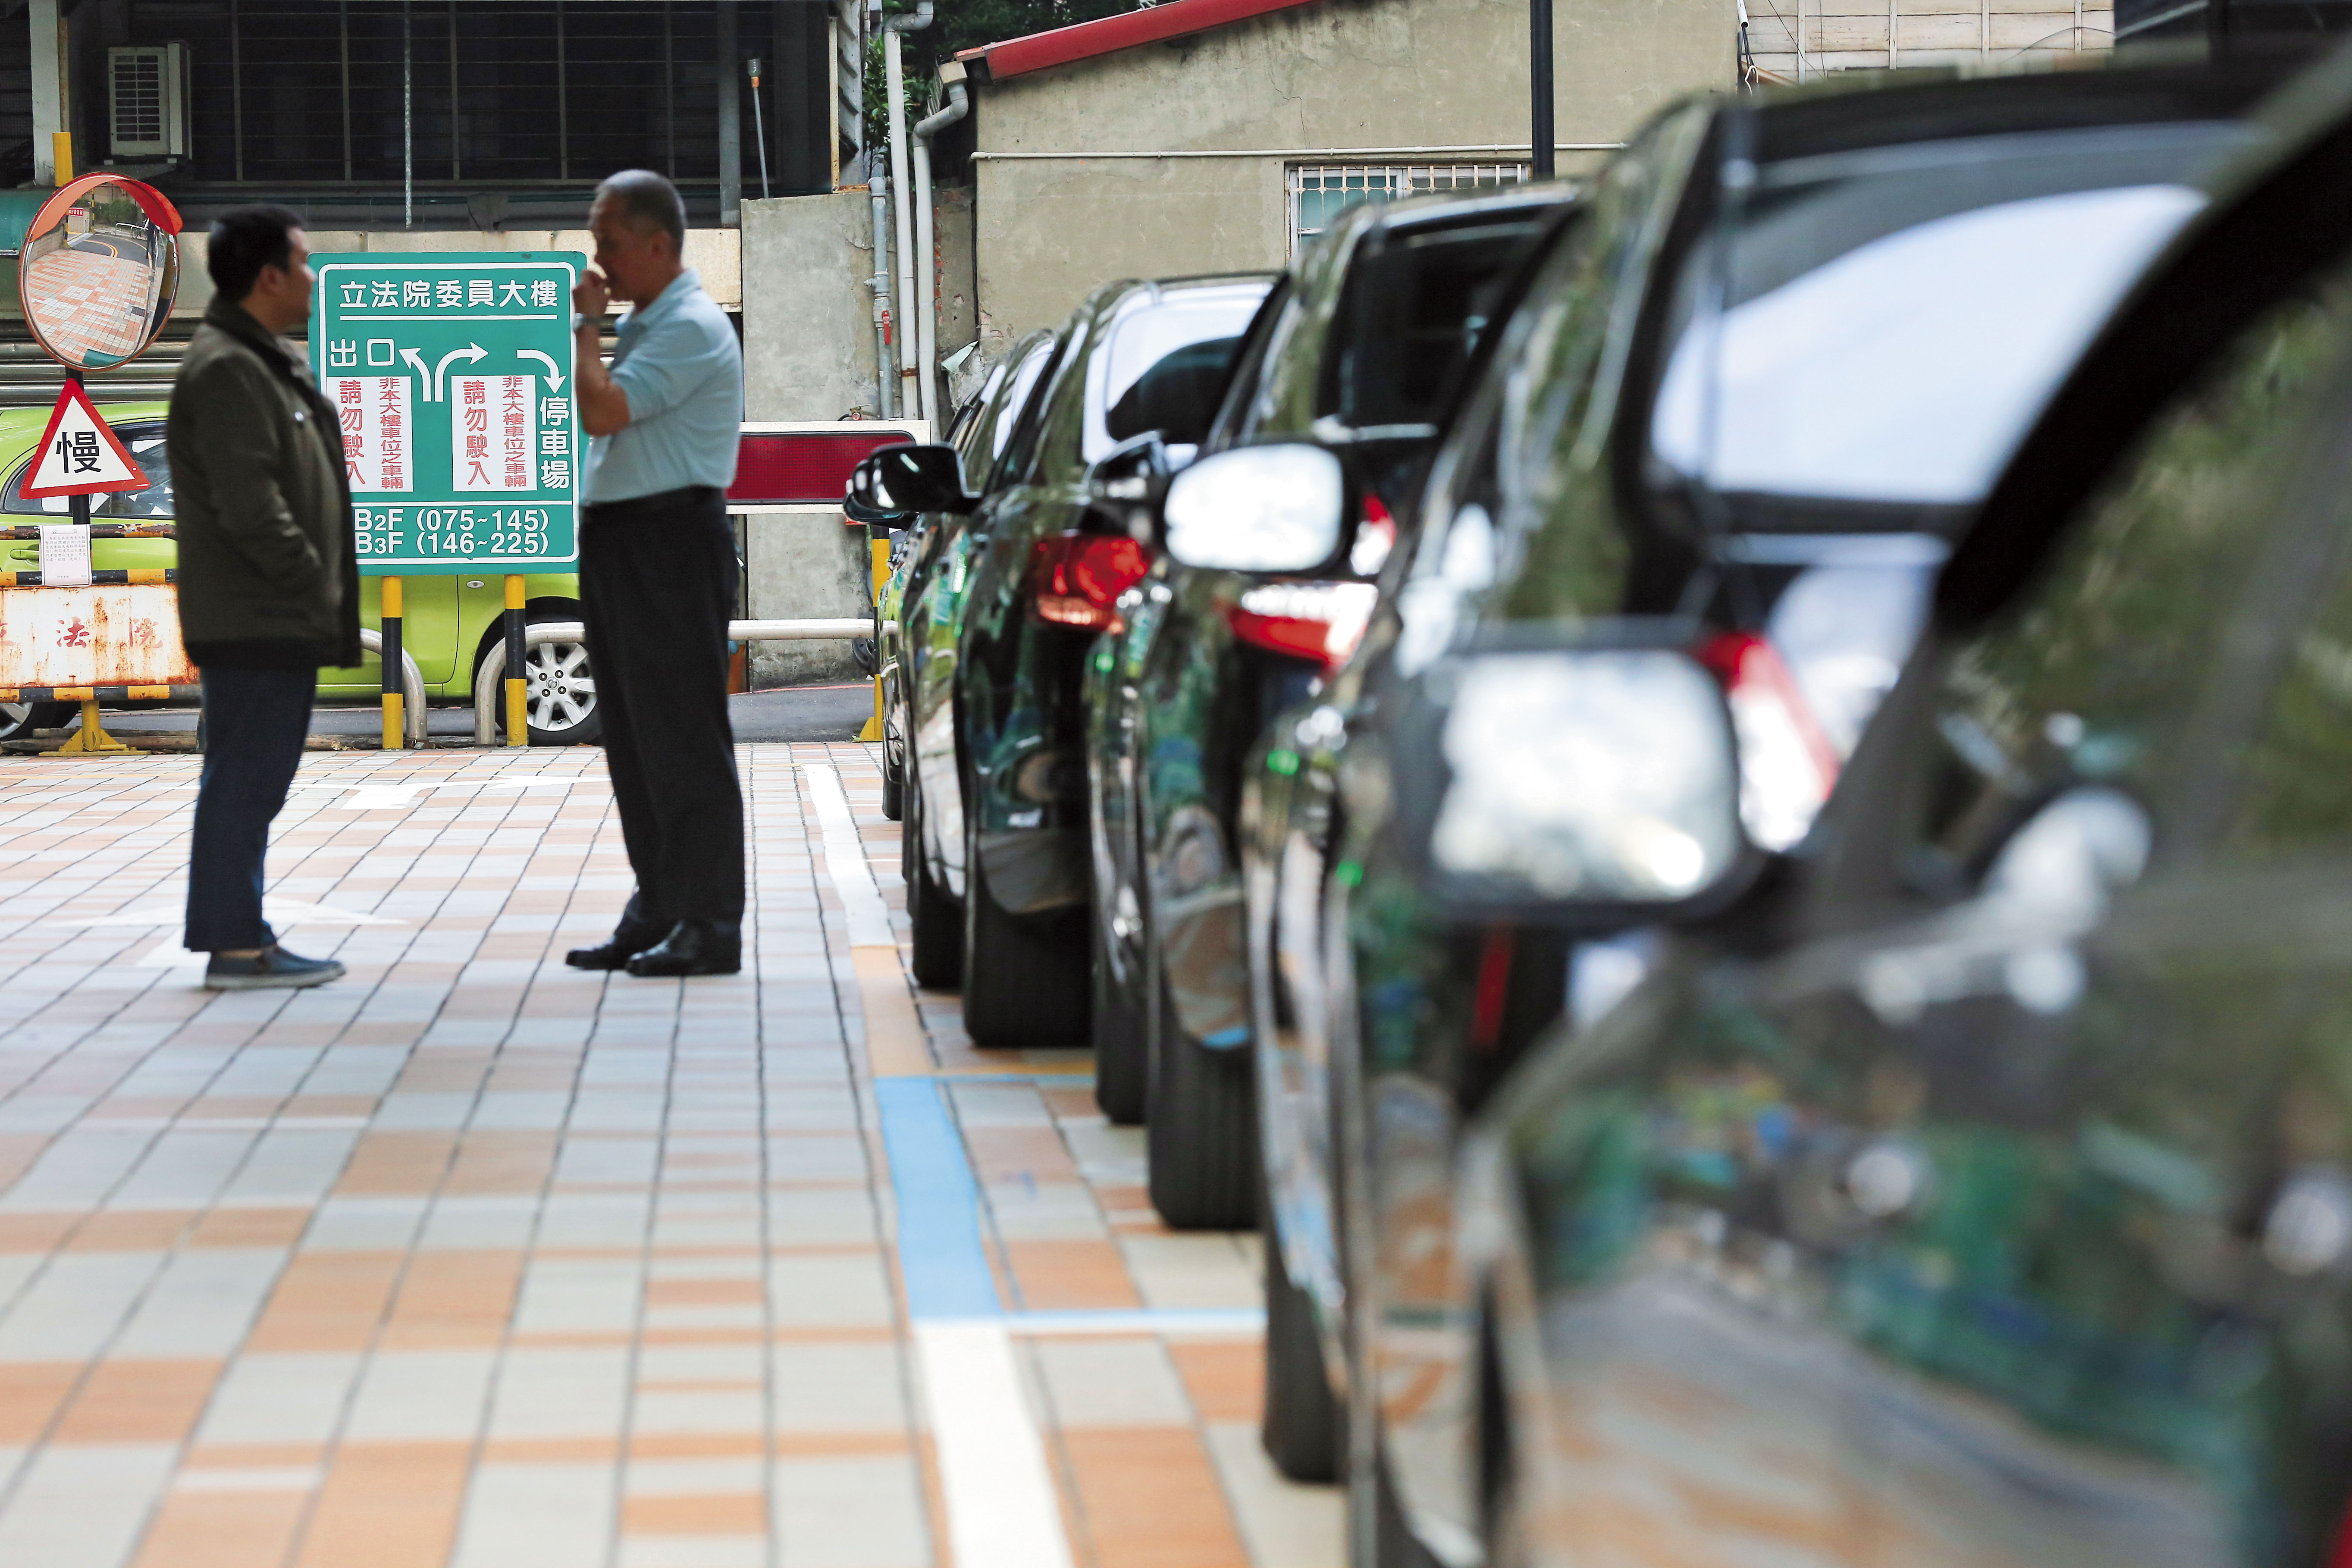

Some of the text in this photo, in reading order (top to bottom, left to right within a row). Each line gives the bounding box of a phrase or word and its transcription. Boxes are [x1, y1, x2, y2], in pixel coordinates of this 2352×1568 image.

[339, 279, 558, 308] 立法院委員大樓
[330, 338, 395, 367] 出口
[56, 431, 102, 474] 慢
[339, 380, 366, 486] 請勿駛入
[379, 377, 404, 489] 非本大樓車位之車輛
[463, 380, 490, 485] 請勿駛入
[502, 376, 527, 487] 非本大樓車位之車輛
[539, 395, 570, 489] 停車場
[355, 508, 549, 533] B2F (075~145)
[355, 531, 549, 555] B3F (146~225)
